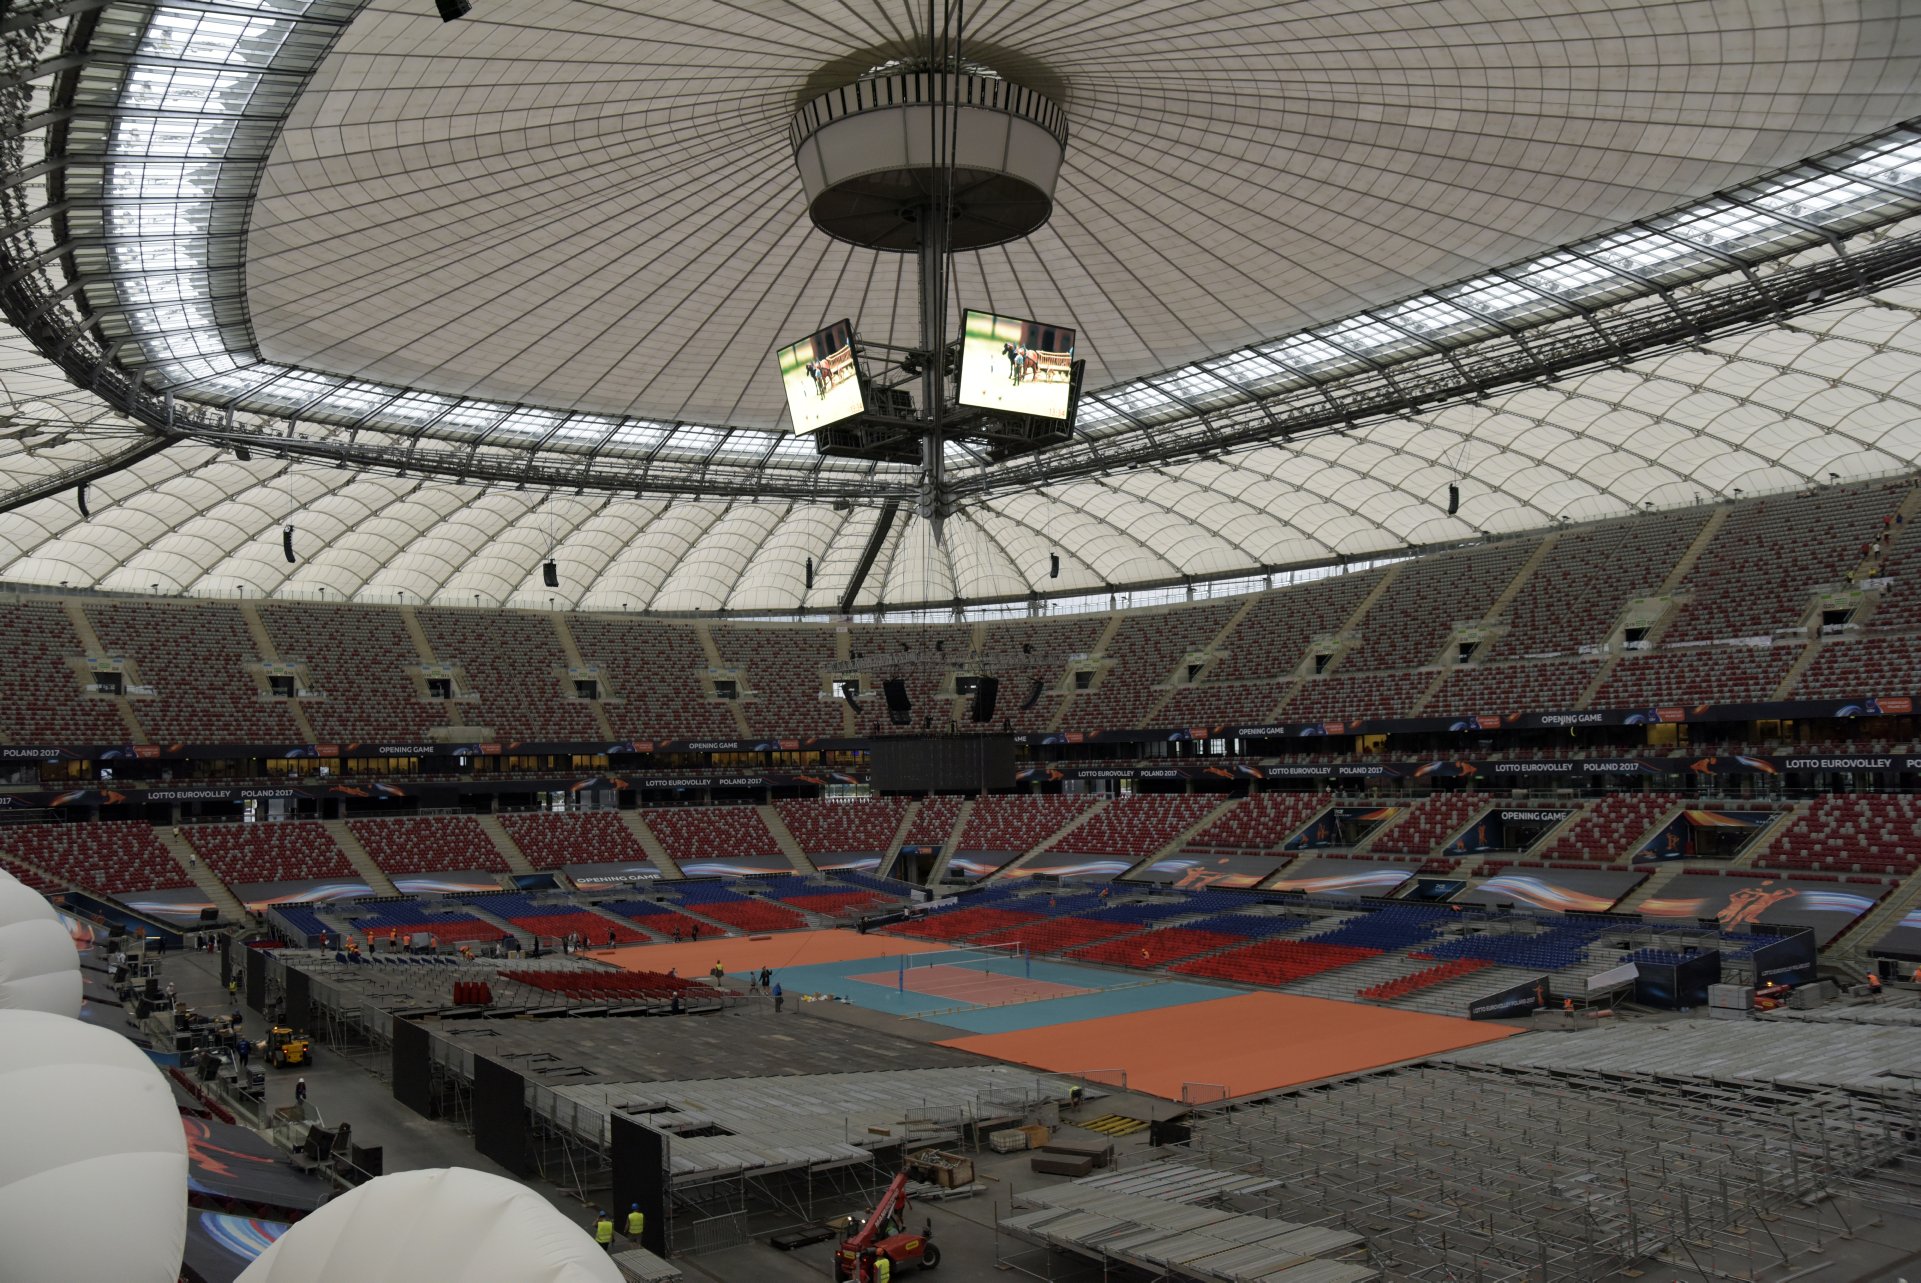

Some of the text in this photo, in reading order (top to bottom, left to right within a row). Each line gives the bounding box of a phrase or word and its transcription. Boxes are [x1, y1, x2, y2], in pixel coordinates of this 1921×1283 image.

[1541, 714, 1602, 723] OPENING GAME
[379, 746, 410, 754] OPENING
[1495, 763, 1638, 772] LOTTO EUROVOLLEY POLAND 2017
[1785, 760, 1819, 769] LOTTO
[1820, 759, 1891, 768] EUROVOLLEY
[147, 792, 175, 800] LOTTO
[176, 791, 230, 799] EUROVOLLEY
[1501, 811, 1567, 821] OPENING GAME
[576, 873, 660, 884] OPENING GAME
